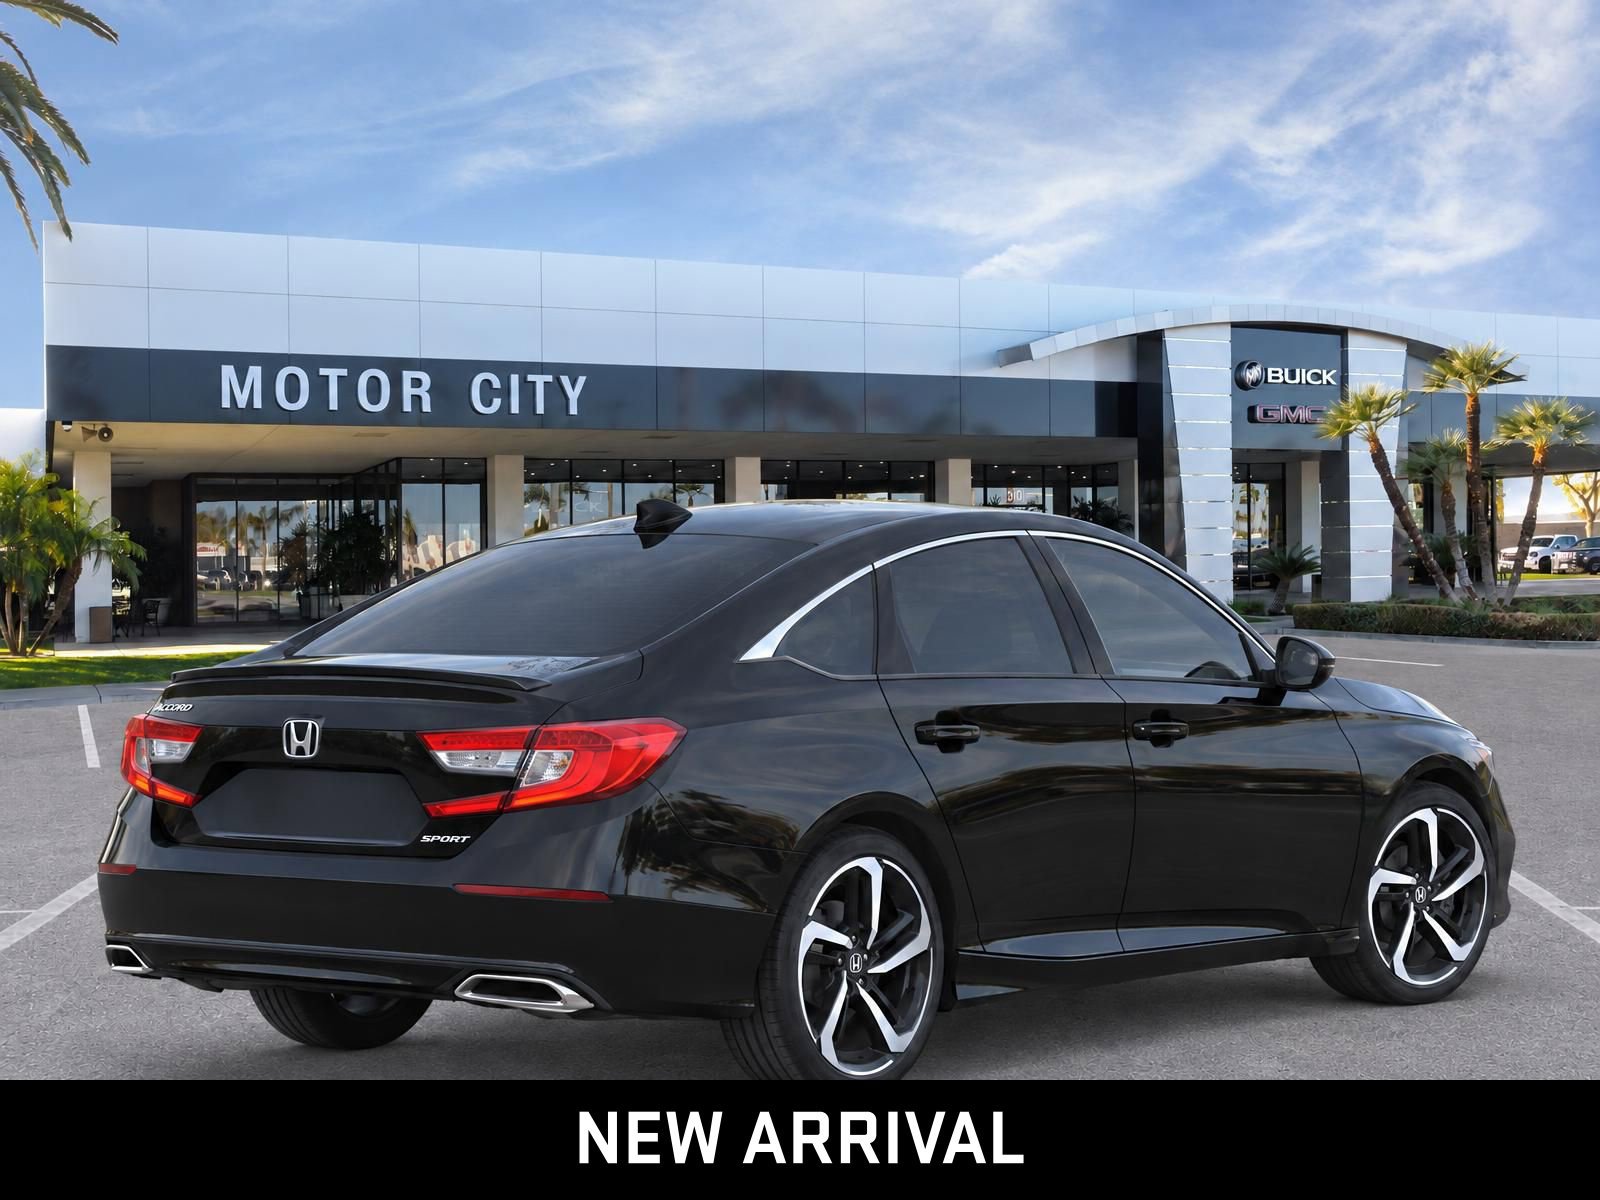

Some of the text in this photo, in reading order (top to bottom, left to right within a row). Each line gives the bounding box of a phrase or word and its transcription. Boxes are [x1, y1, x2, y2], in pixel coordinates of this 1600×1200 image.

[1267, 367, 1337, 386] BUICK
[221, 364, 587, 416] MOTOR CITY
[1257, 404, 1327, 424] GMC
[420, 835, 472, 843] SPORT
